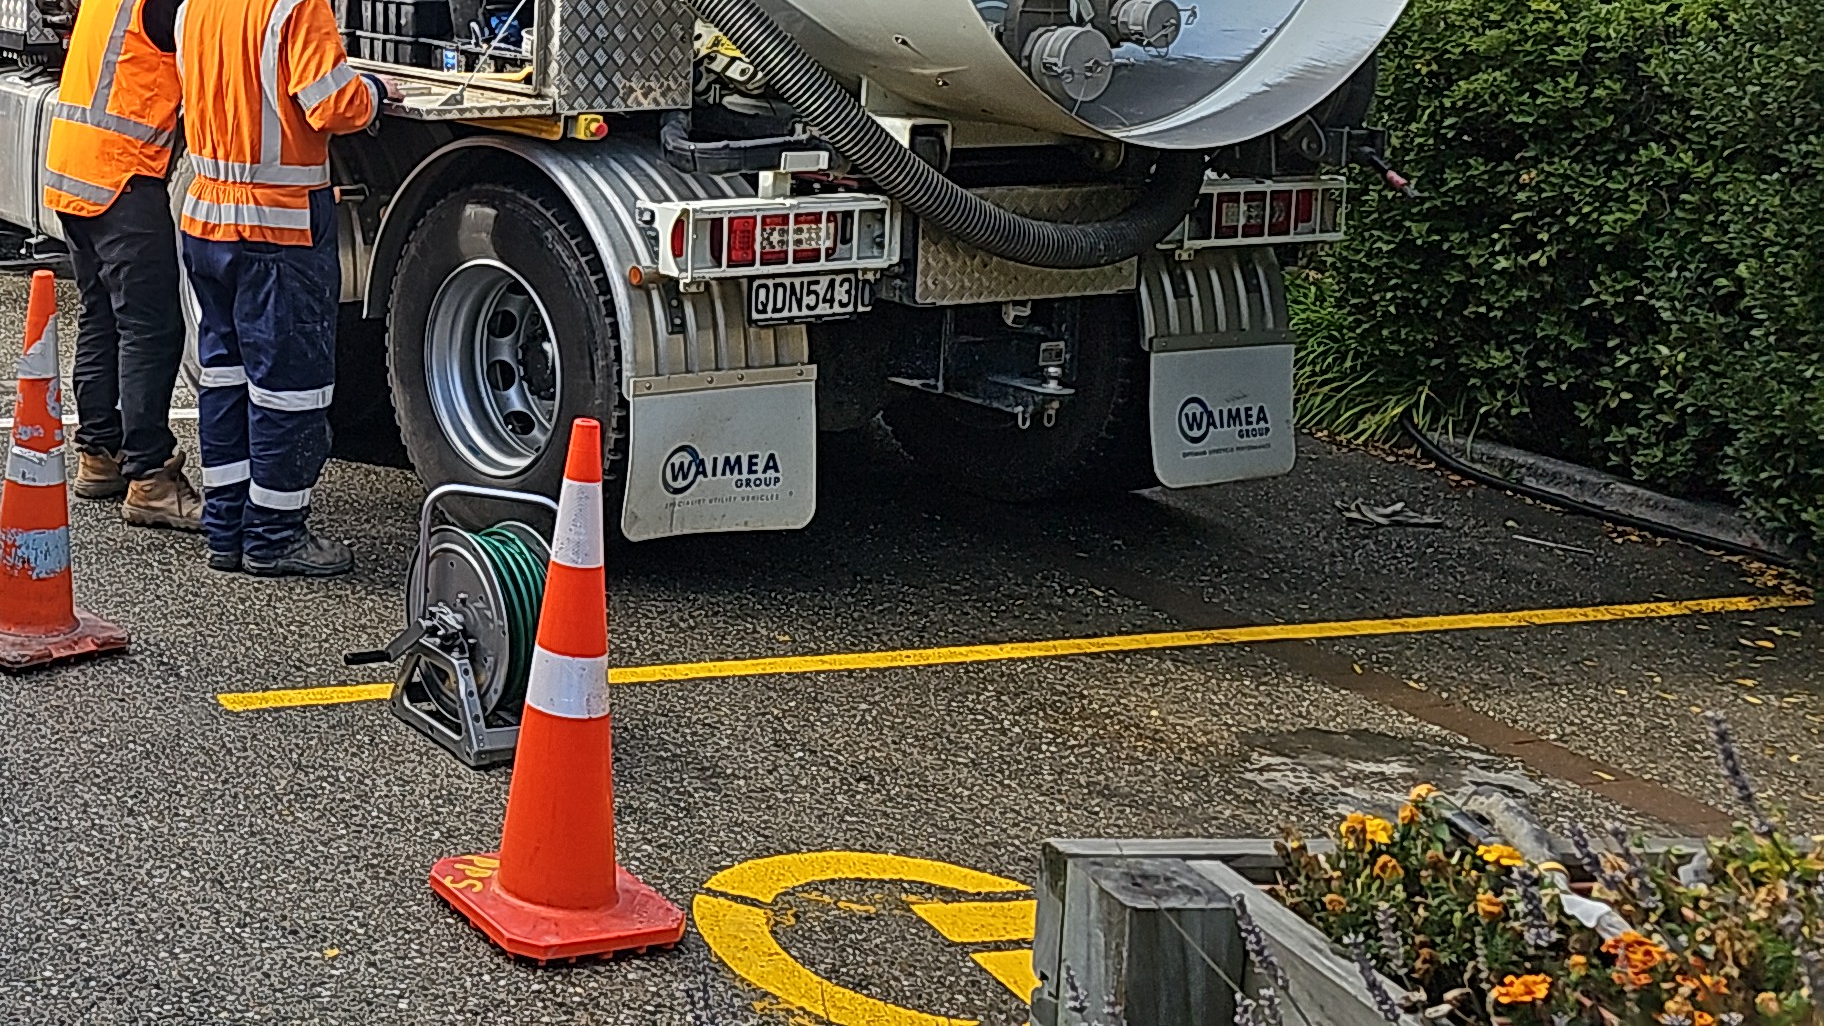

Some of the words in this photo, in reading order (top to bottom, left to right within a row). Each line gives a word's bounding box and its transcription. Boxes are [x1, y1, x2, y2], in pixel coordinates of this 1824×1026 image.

[754, 277, 853, 315] QDN543
[1182, 405, 1269, 431] WAIMEA
[1238, 427, 1270, 439] GROUP
[669, 453, 781, 482] WAIMEA
[735, 476, 781, 489] GROUP
